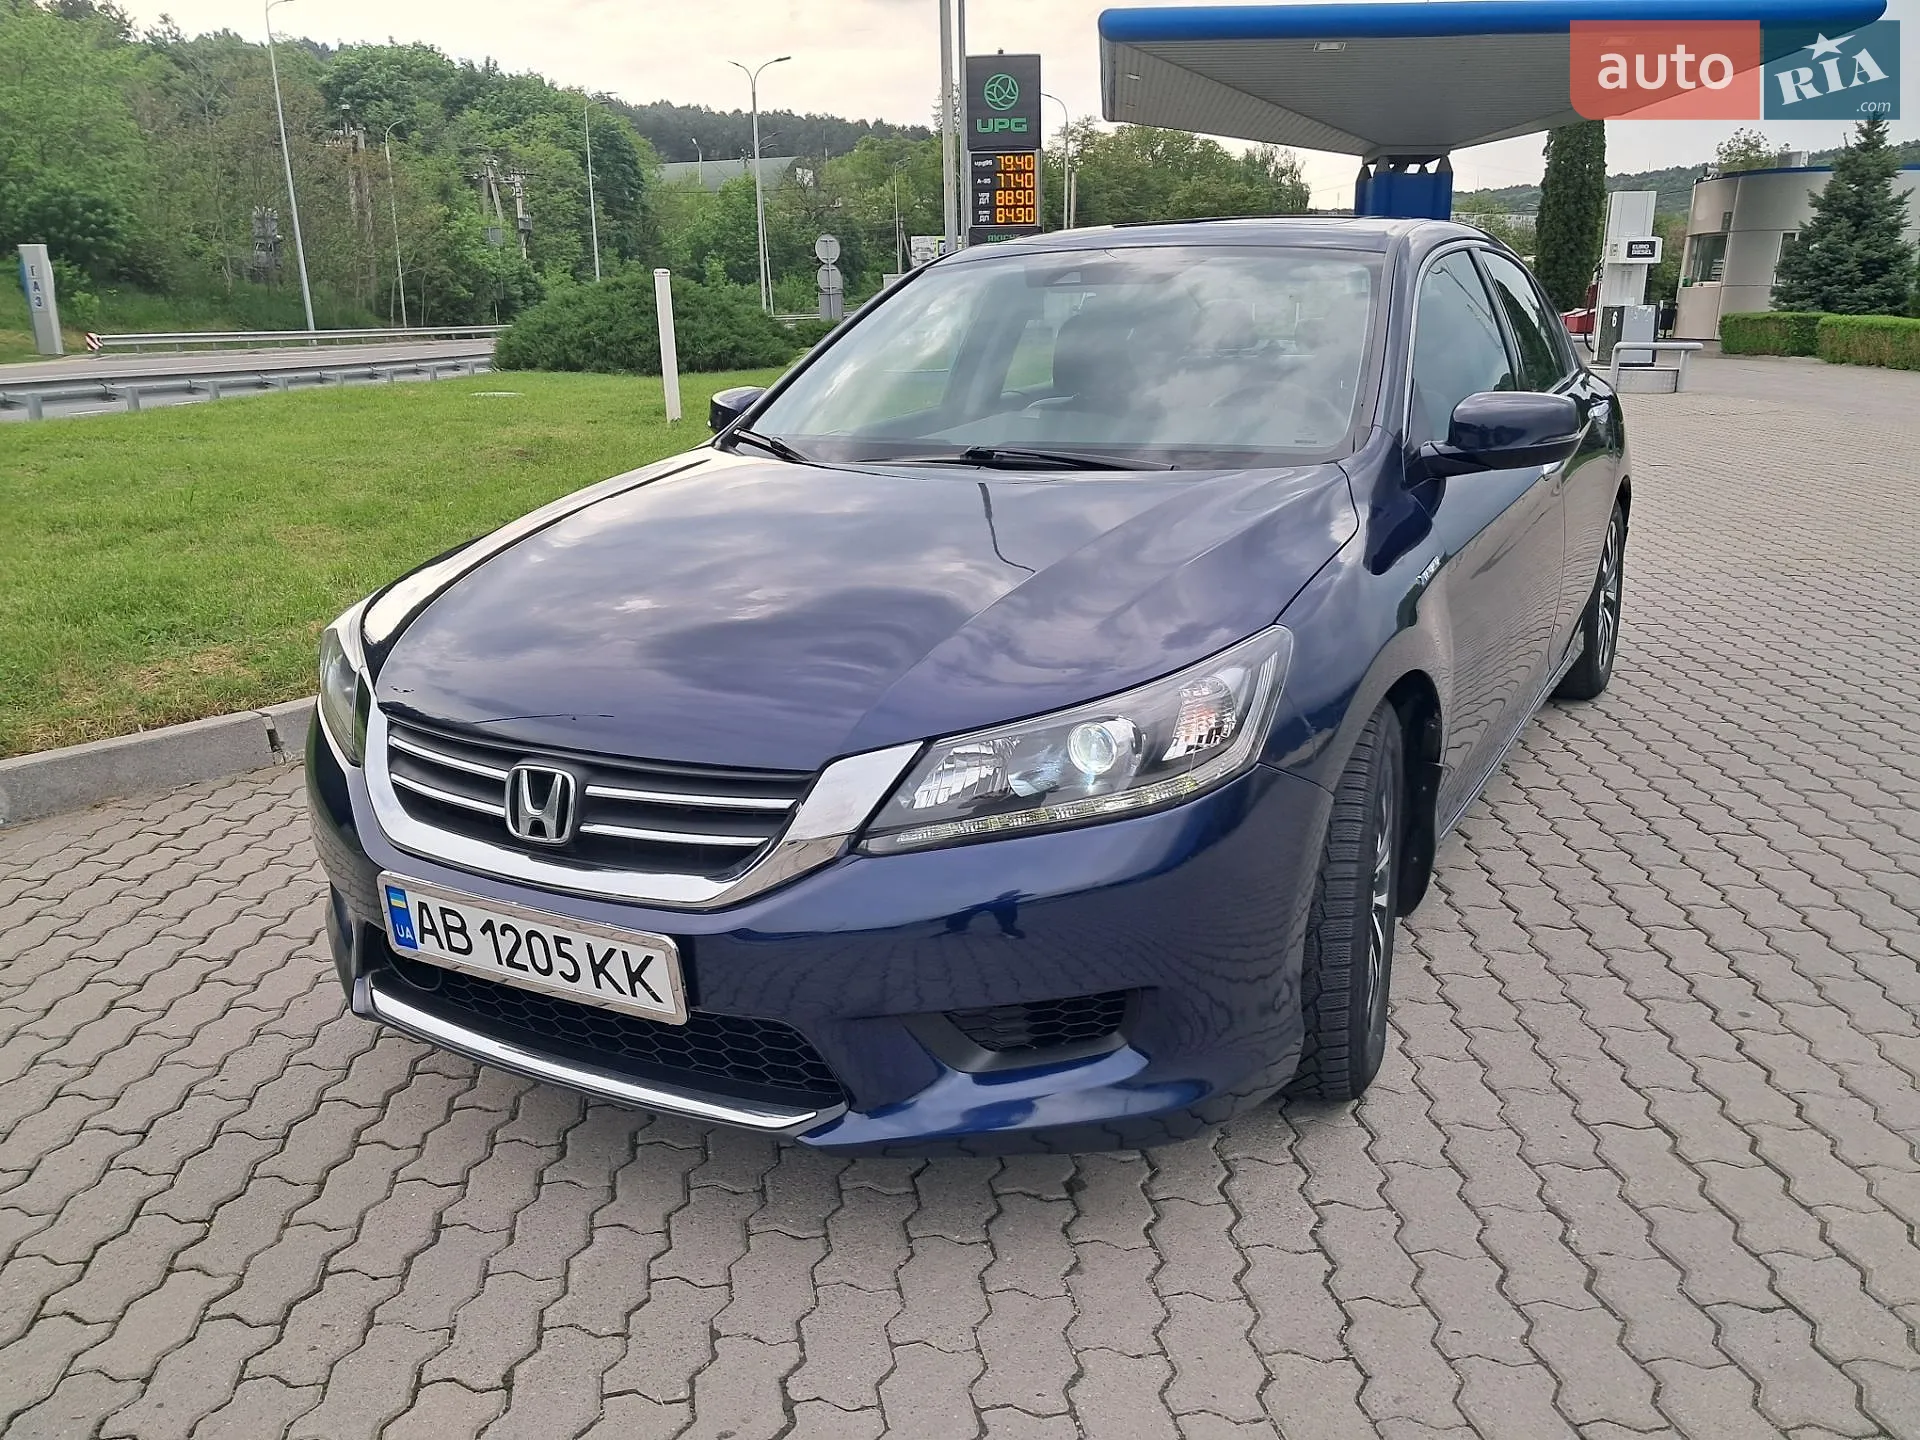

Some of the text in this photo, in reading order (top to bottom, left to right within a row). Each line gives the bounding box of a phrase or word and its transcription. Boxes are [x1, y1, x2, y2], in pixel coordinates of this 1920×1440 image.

[977, 119, 1027, 133] UPG
[1611, 310, 1618, 328] 6
[396, 924, 414, 942] UA
[417, 900, 664, 1003] AB 1205 KK
